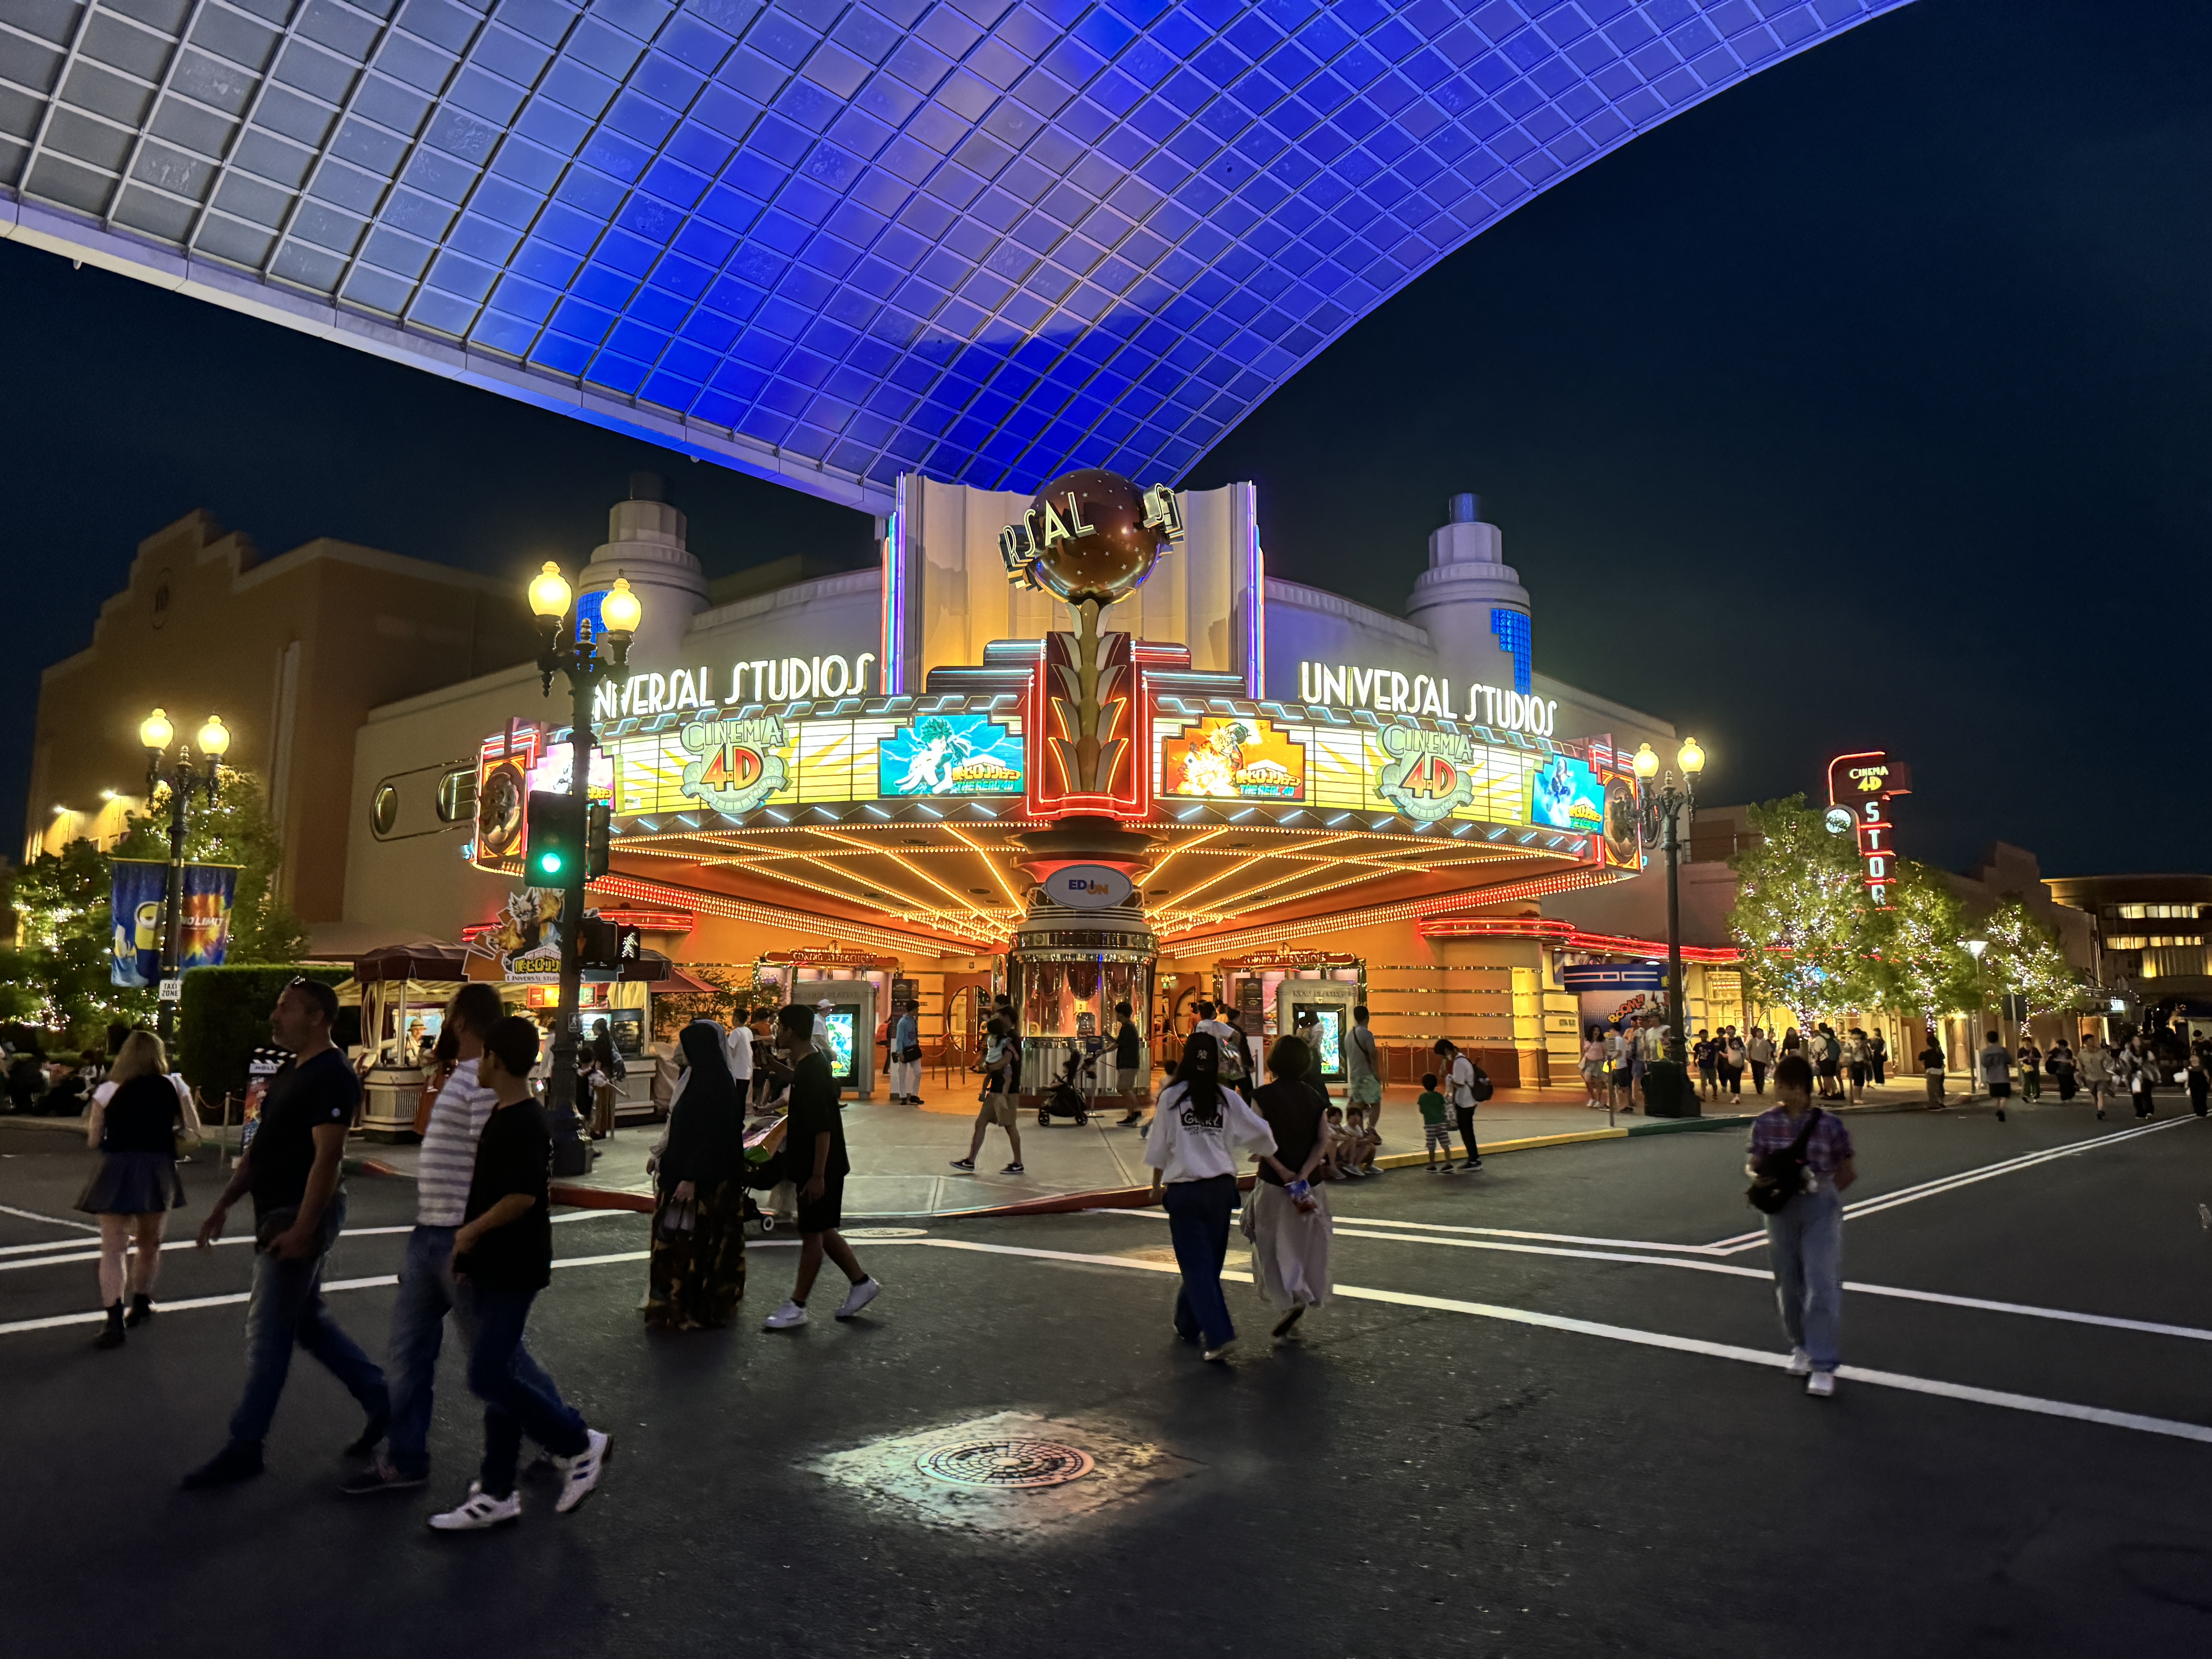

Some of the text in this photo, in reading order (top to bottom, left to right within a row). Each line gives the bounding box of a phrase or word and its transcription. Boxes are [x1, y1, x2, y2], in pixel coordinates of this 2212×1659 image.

[592, 653, 875, 721] NIVERSAL STUDIOS
[1302, 661, 1557, 737] UNIVERSAL STUDIOS
[680, 715, 786, 756] CINEMA
[1382, 723, 1474, 760] CINEMA
[957, 781, 975, 791] THE
[1240, 785, 1258, 795] THE
[1849, 766, 1889, 779] CINEMA
[1865, 801, 1886, 905] STOR
